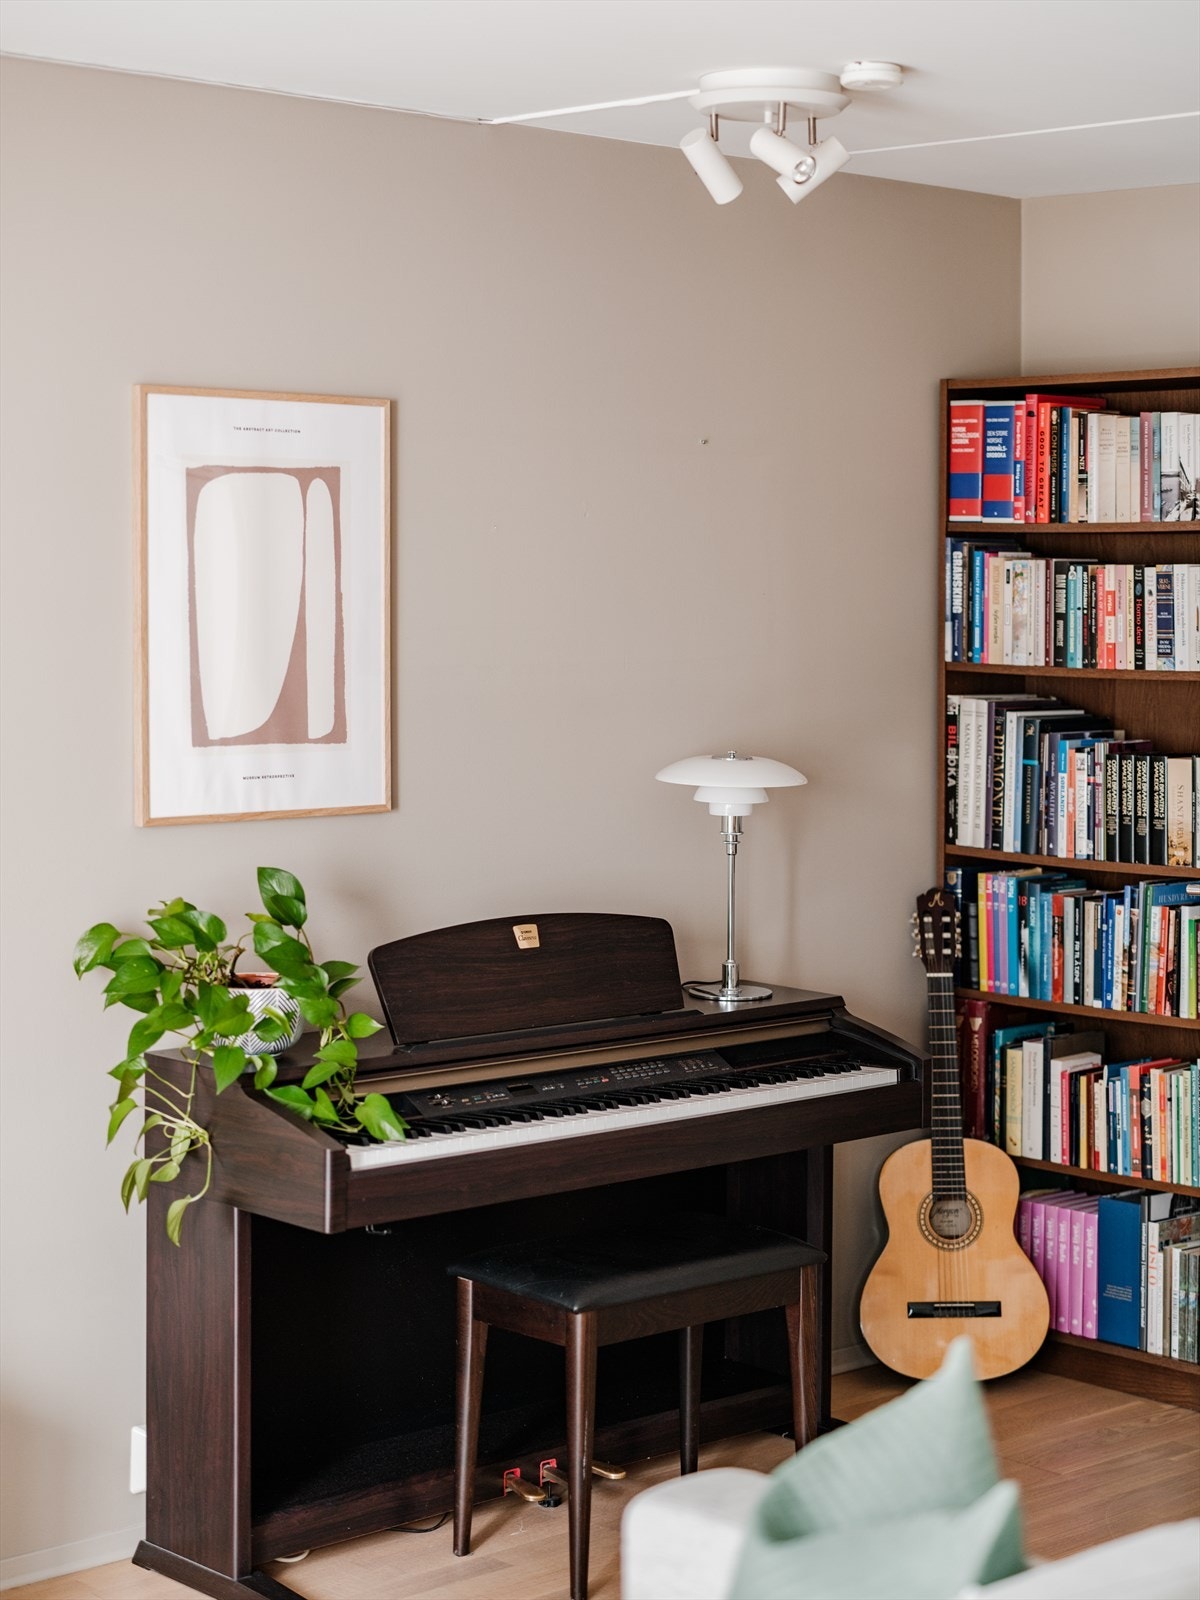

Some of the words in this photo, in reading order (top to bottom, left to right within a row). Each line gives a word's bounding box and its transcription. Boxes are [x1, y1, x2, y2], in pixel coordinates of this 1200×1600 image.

[1039, 462, 1044, 473] TO
[952, 551, 962, 614] GRANSKING
[1056, 574, 1066, 588] DAN
[1056, 589, 1066, 613] BROWN
[1146, 599, 1155, 642] Sapiens
[992, 735, 1004, 828] PIEMONTE
